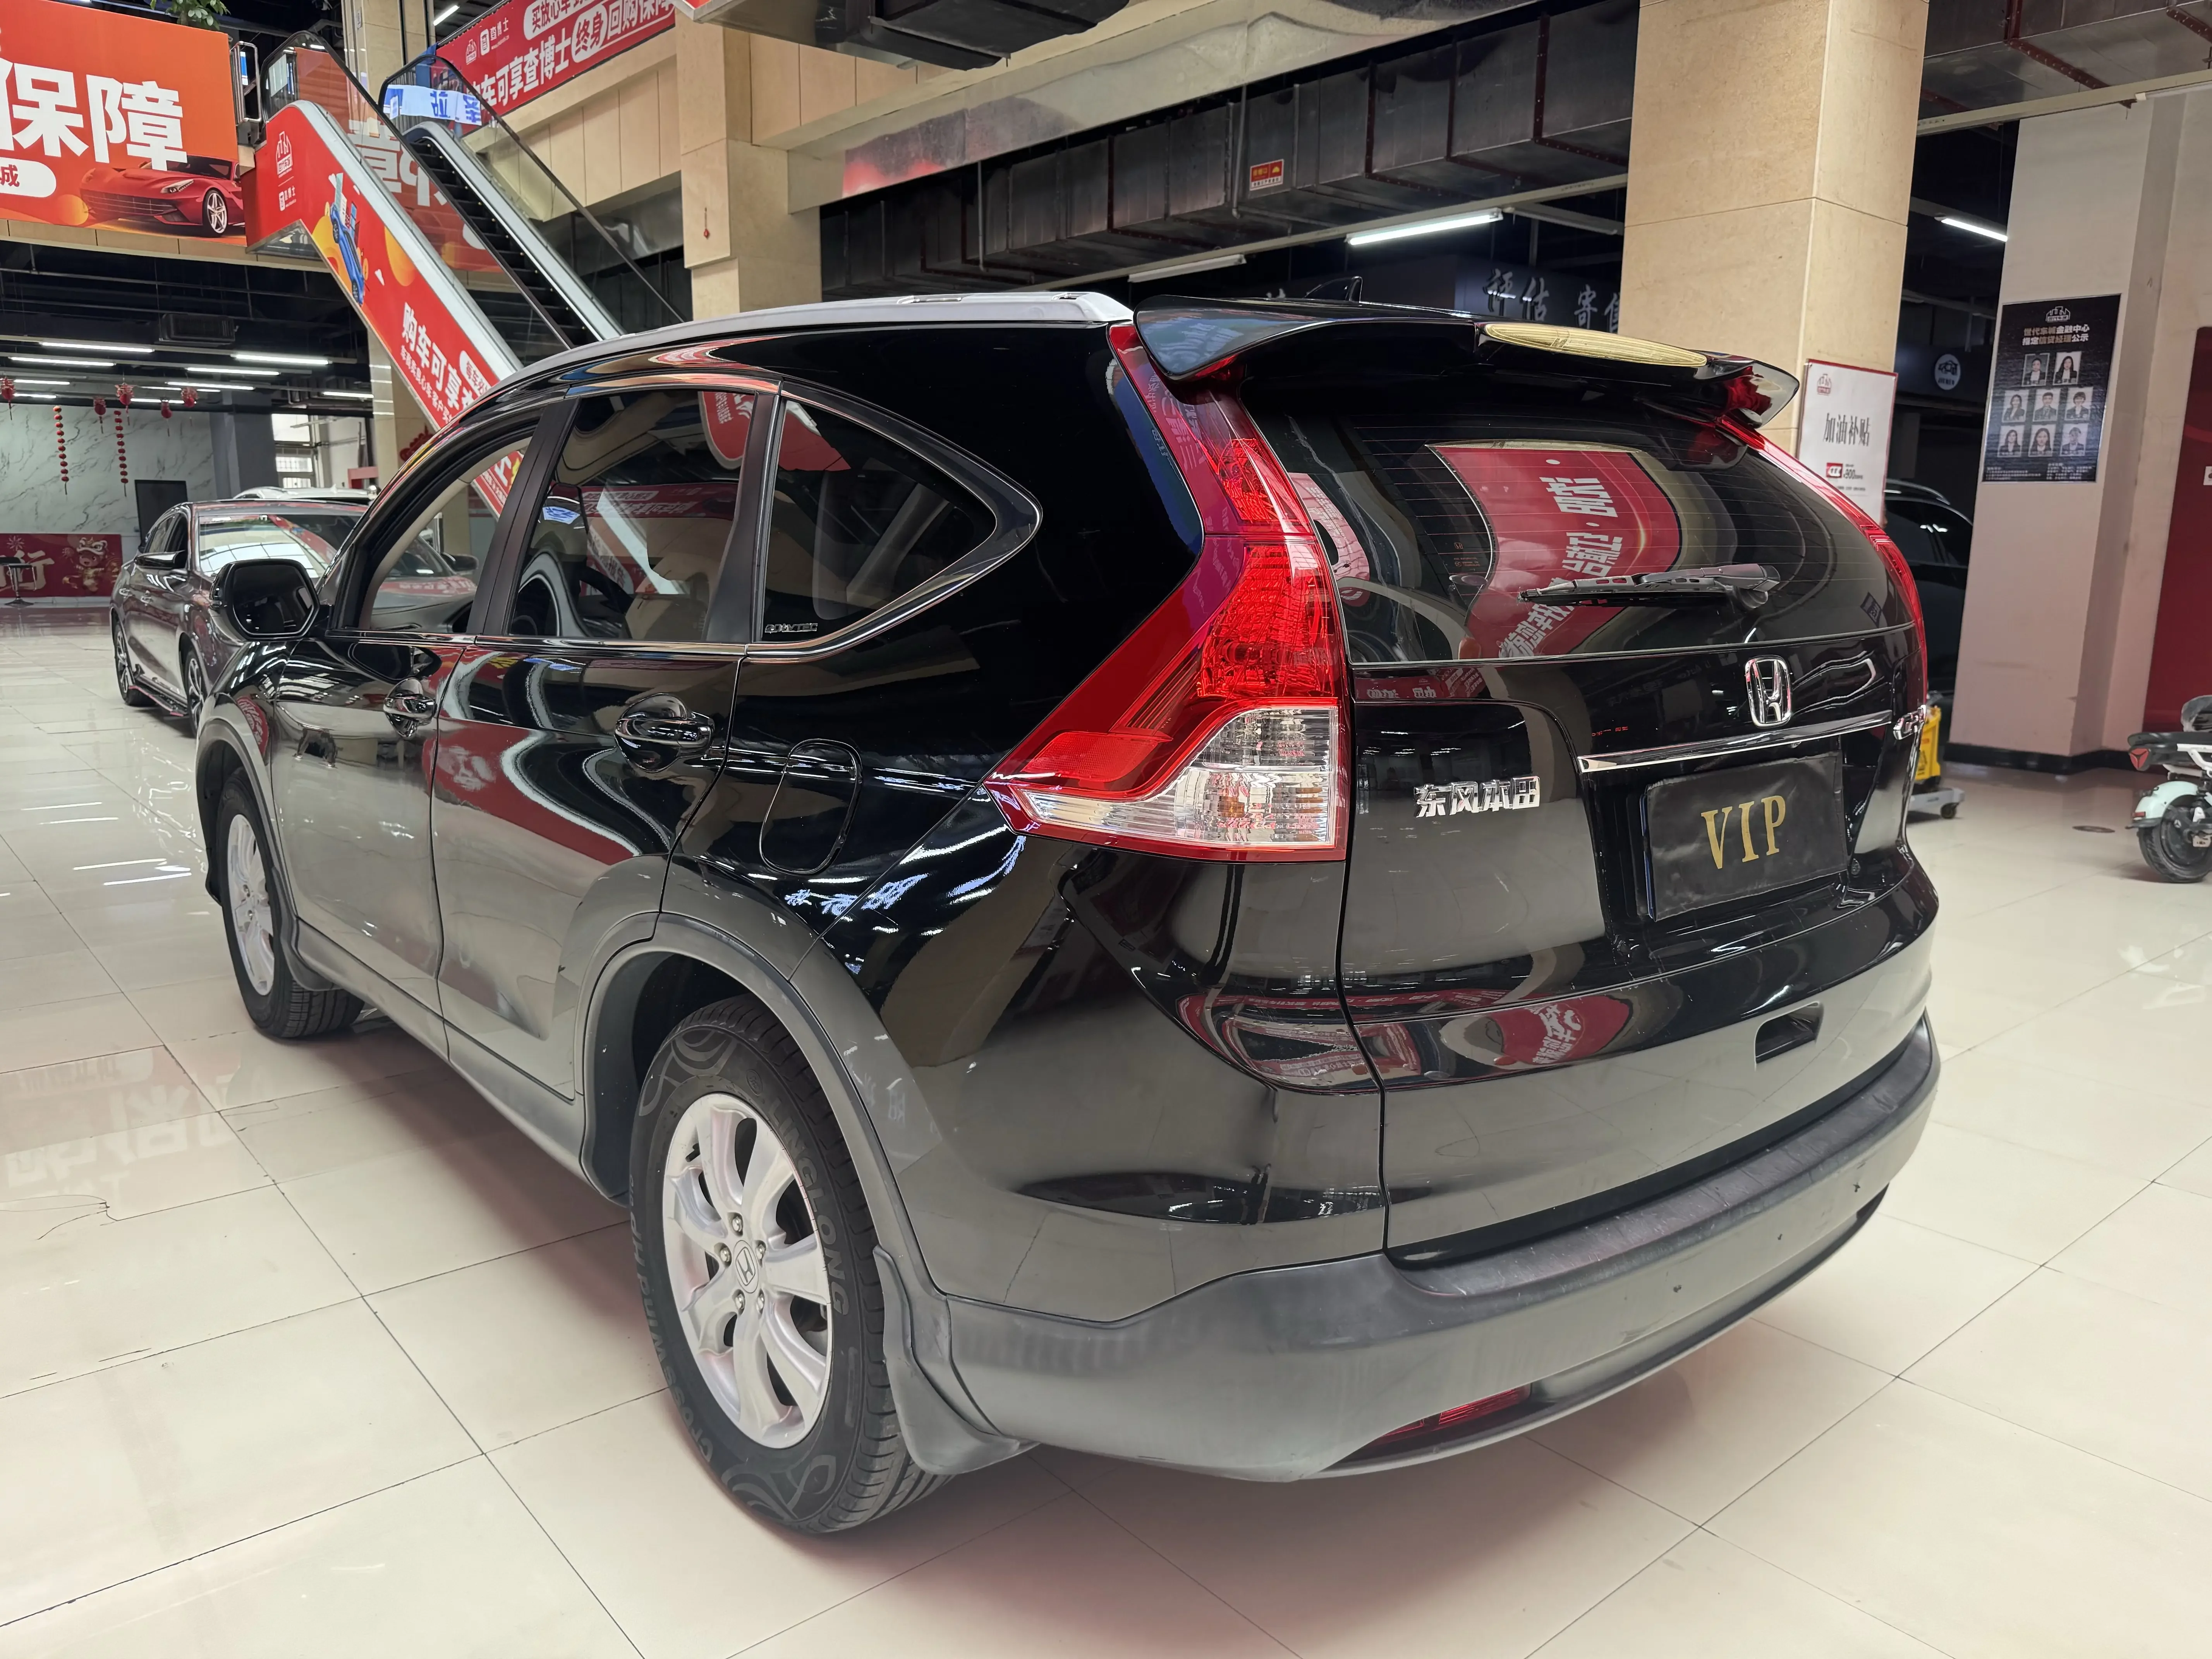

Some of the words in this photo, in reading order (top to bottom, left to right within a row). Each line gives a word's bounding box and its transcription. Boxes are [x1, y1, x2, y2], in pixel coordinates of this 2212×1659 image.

[532, 0, 588, 33] 买放心车
[0, 58, 188, 171] 保障
[1822, 412, 1871, 447] 加油补贴
[1413, 775, 1540, 818] 东风本田
[1701, 795, 1786, 869] VIP
[768, 1096, 850, 1316] LINGLONG
